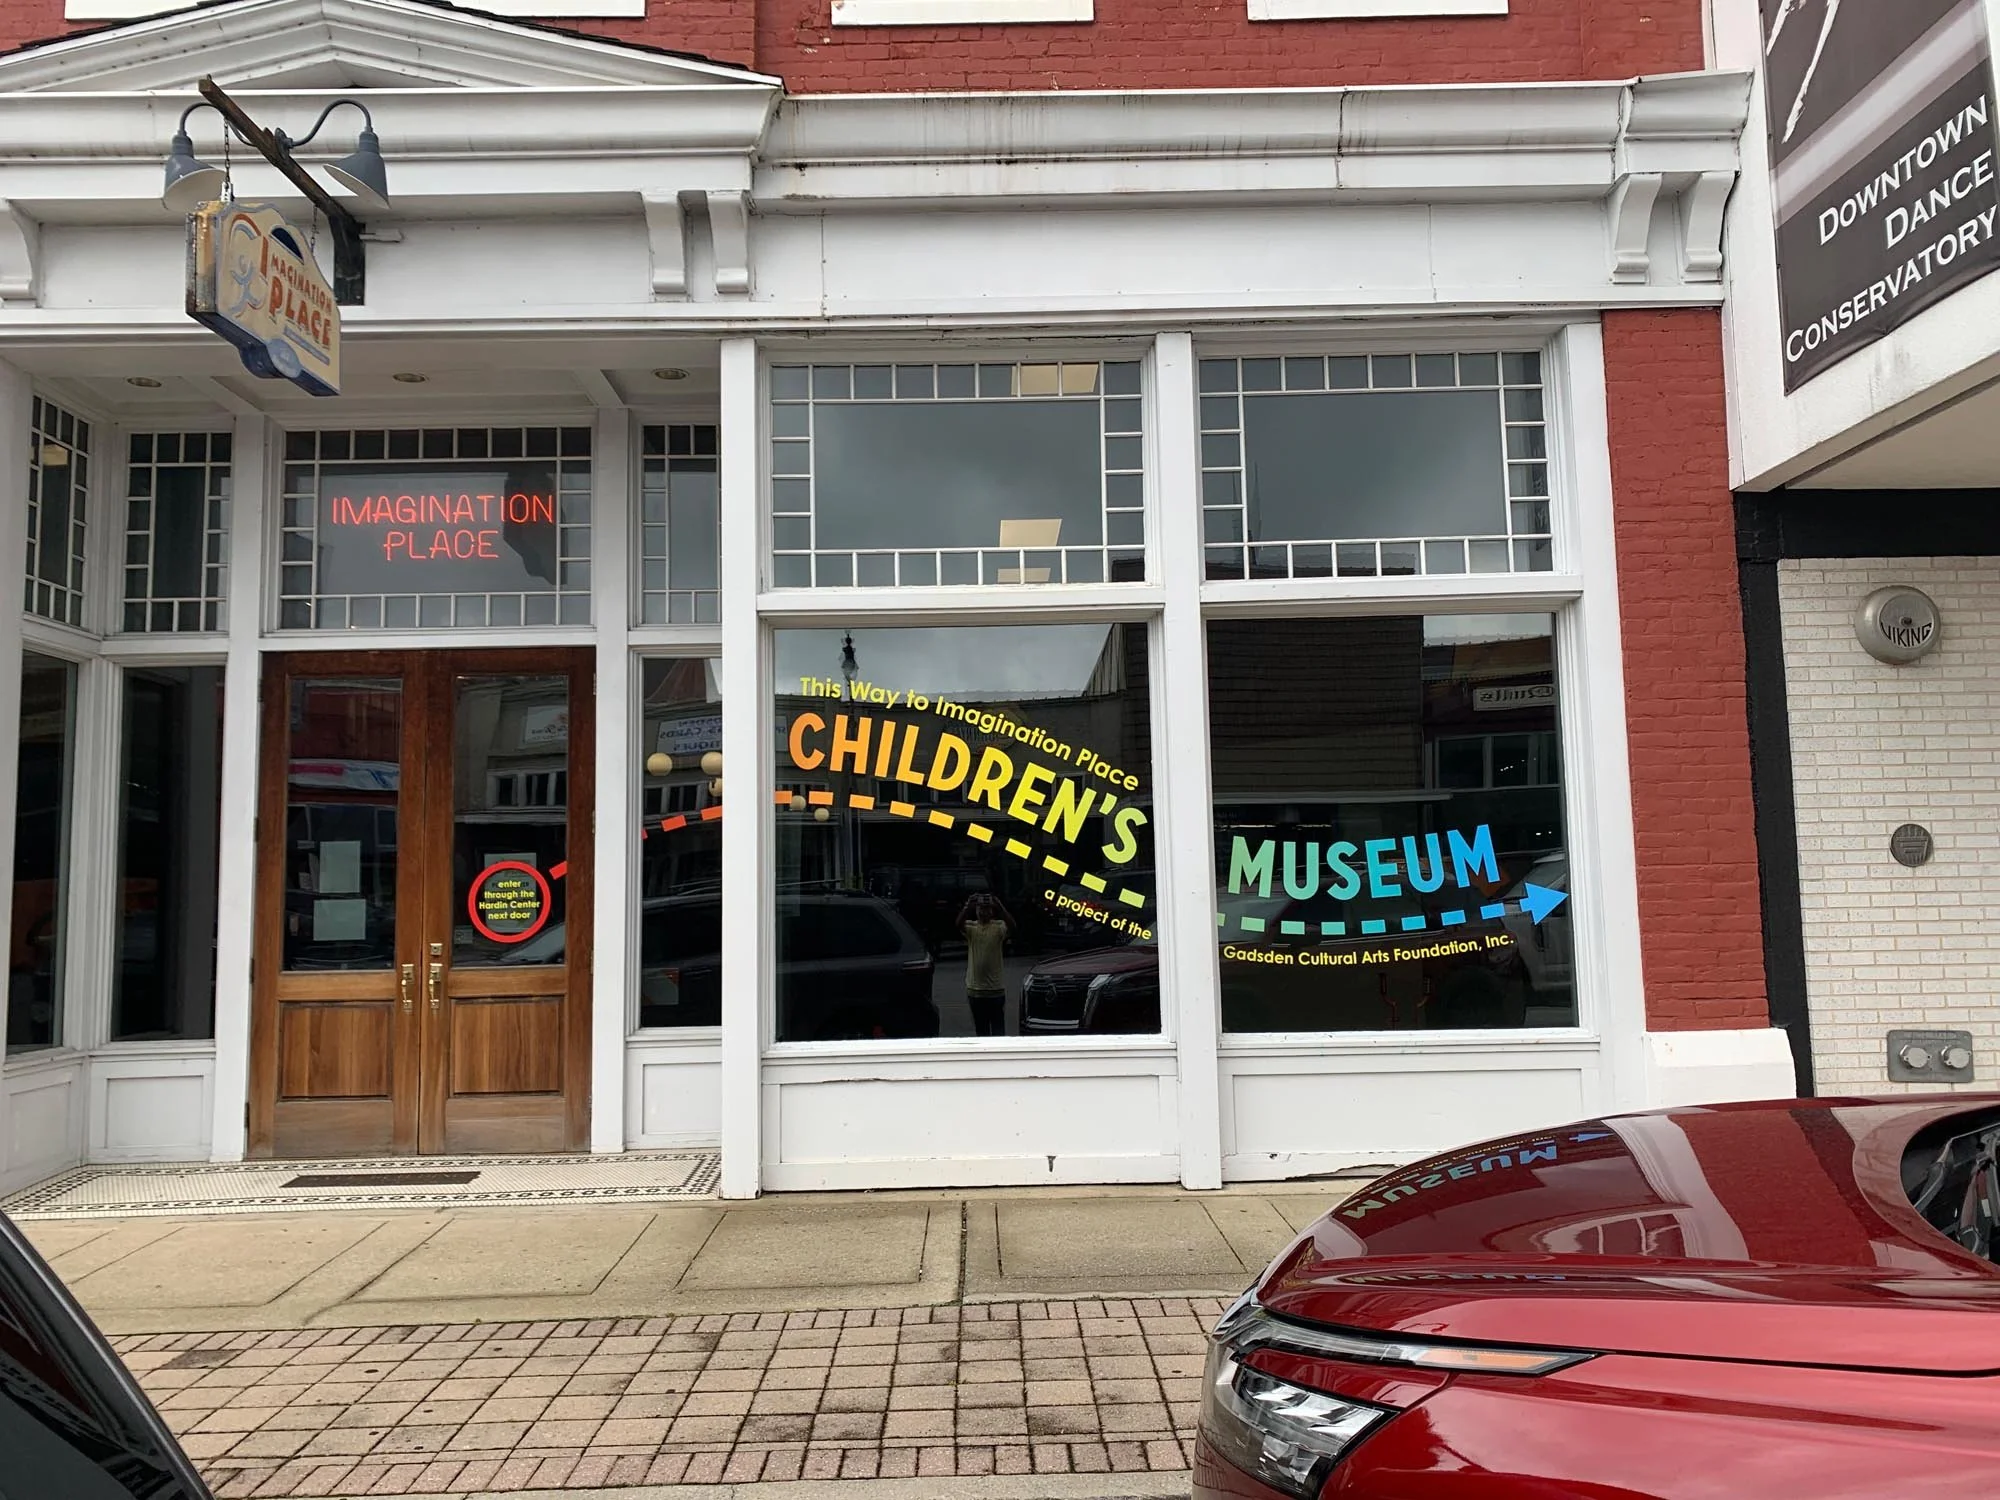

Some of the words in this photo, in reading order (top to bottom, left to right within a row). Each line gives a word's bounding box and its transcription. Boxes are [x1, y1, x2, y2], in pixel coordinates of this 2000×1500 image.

[1819, 95, 1988, 246] DOWNTOWN
[1886, 150, 1994, 249] DANCE
[260, 236, 332, 313] IMAGINATION
[1786, 205, 1998, 362] CONSERVATORY
[269, 276, 331, 346] PLACE
[331, 494, 553, 524] IMAGINATION
[383, 530, 499, 561] PLACE
[1880, 621, 1932, 648] VIKING
[800, 675, 843, 698] This
[850, 680, 901, 709] Way
[905, 689, 929, 711] to
[935, 695, 1072, 761] Imagination
[1075, 748, 1139, 791] Place
[789, 712, 1148, 864] CHILDREN'S
[497, 880, 522, 889] enter
[1228, 824, 1500, 900] MUSEUM
[478, 901, 508, 910] Hardin
[510, 900, 541, 909] Center
[484, 890, 519, 900] through
[520, 889, 535, 898] the
[487, 912, 508, 920] next
[509, 910, 532, 919] door
[1044, 889, 1056, 901] a
[1056, 894, 1109, 924] project
[1110, 918, 1127, 931] of
[1128, 921, 1152, 940] the
[1223, 945, 1294, 965] Gadsden
[1298, 951, 1357, 966] Cultural
[1361, 949, 1390, 964] Arts
[1393, 940, 1482, 962] Foundation,
[1485, 934, 1514, 949] Inc.
